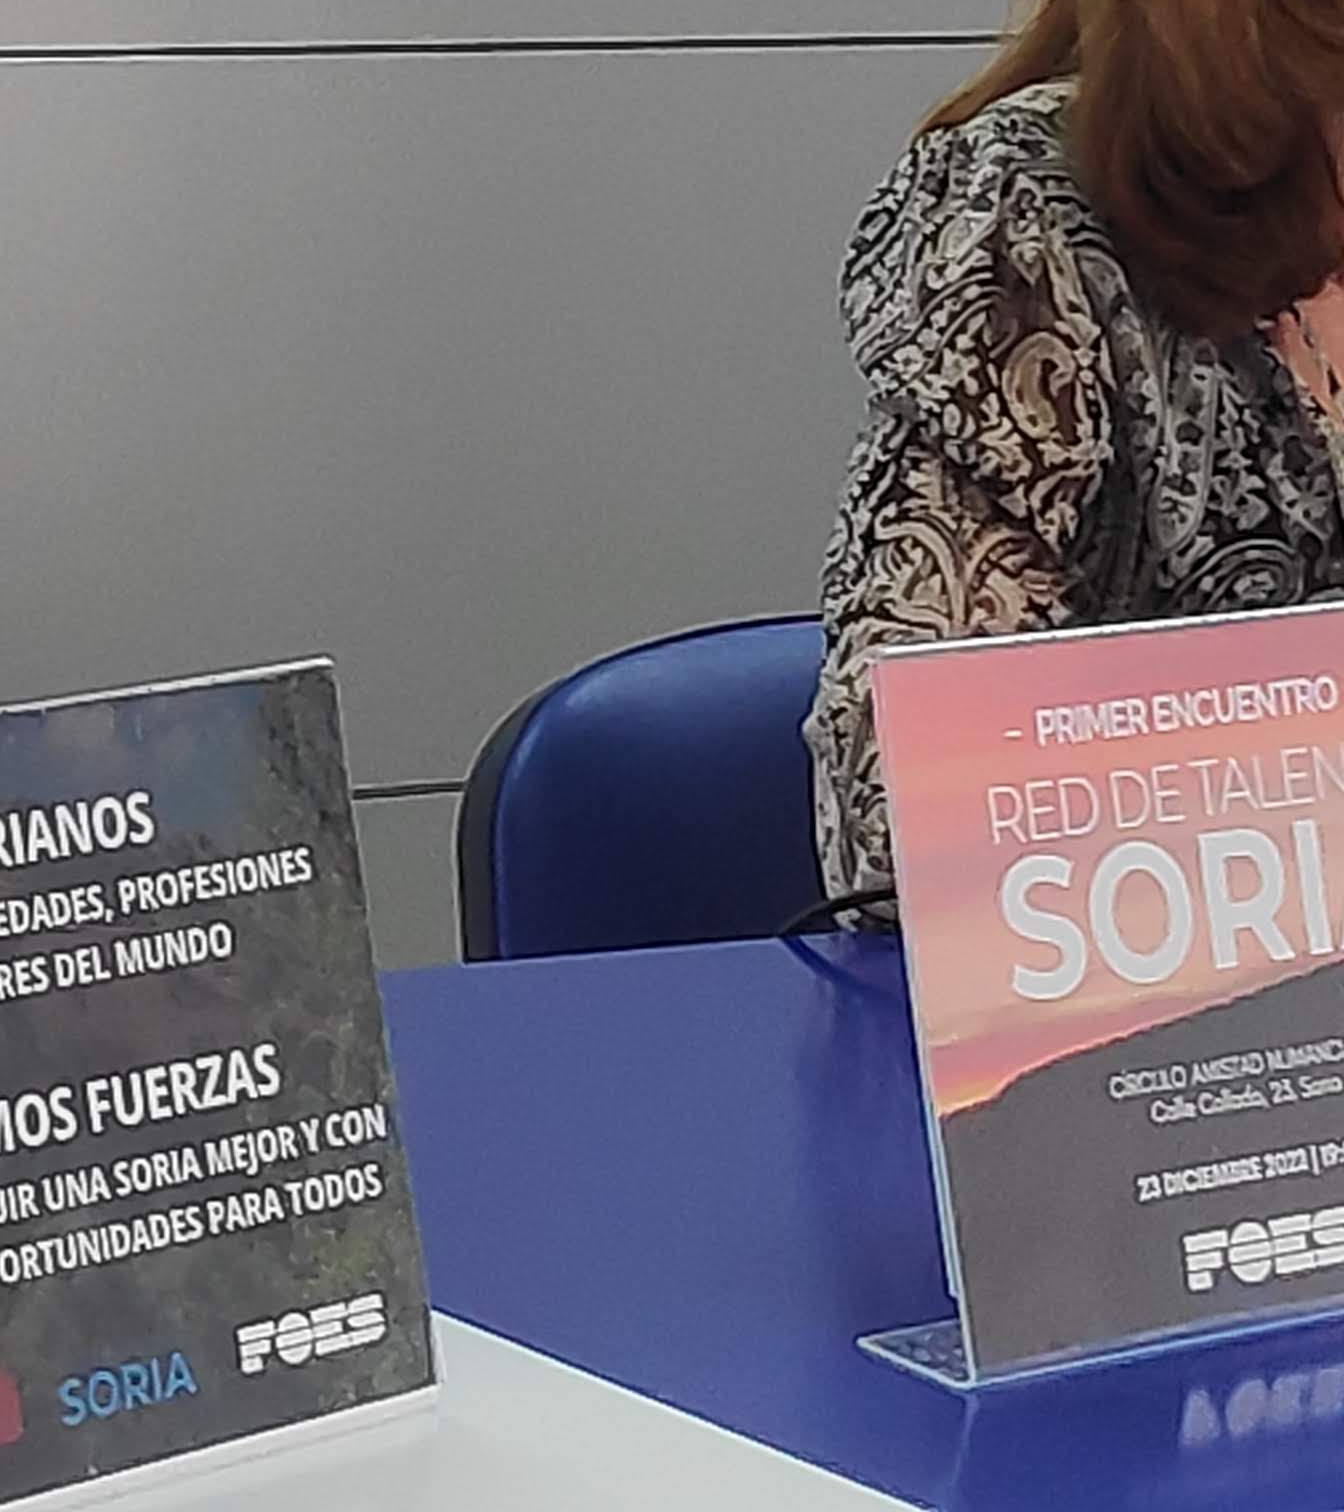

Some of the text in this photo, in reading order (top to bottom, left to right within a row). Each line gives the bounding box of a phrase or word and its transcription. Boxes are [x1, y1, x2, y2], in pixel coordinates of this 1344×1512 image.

[1035, 698, 1149, 746] PRIMER
[1157, 675, 1340, 732] ENCUENTRO
[988, 776, 1100, 845] RED
[1110, 764, 1186, 829] DE
[118, 847, 311, 915] PROFESIONES
[54, 945, 111, 987] DEL
[113, 922, 233, 977] MUNDO
[86, 1043, 281, 1133] FUERZAS
[1151, 1096, 1196, 1123] Calle
[42, 1166, 111, 1211] UNA
[113, 1147, 203, 1197] SORIA
[205, 1125, 299, 1175] MEJOR
[301, 1118, 319, 1153] Y
[325, 1103, 388, 1147] CON
[1137, 1175, 1161, 1202] 23
[1163, 1156, 1263, 1195] DICIEMBRE
[1264, 1150, 1308, 1178] 2022
[206, 1188, 285, 1234] PARA
[283, 1164, 383, 1216] TODOS
[236, 1293, 388, 1375] FOES
[57, 1350, 198, 1427] SORIA
